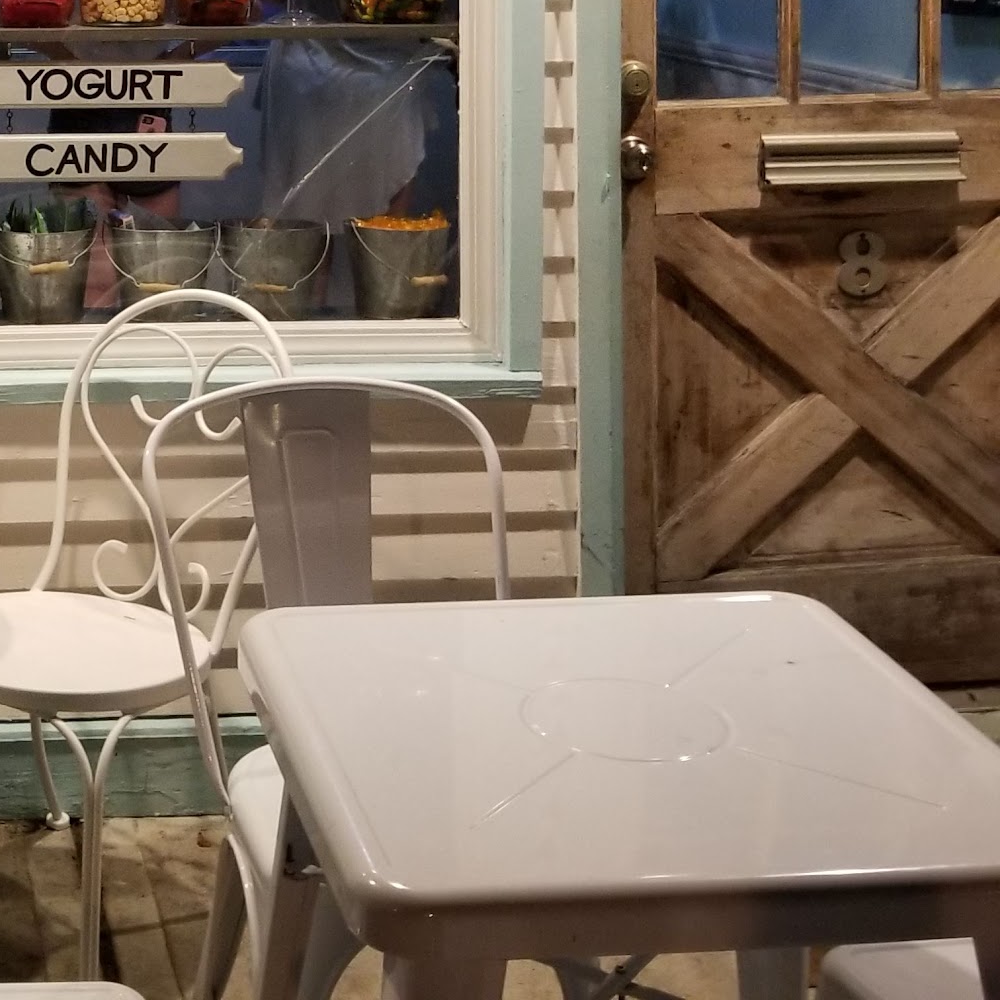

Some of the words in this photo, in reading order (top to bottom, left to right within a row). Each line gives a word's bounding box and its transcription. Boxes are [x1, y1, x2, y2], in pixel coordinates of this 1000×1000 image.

[17, 68, 183, 101] YOGURT
[25, 142, 168, 176] CANDY
[838, 230, 886, 297] 8
